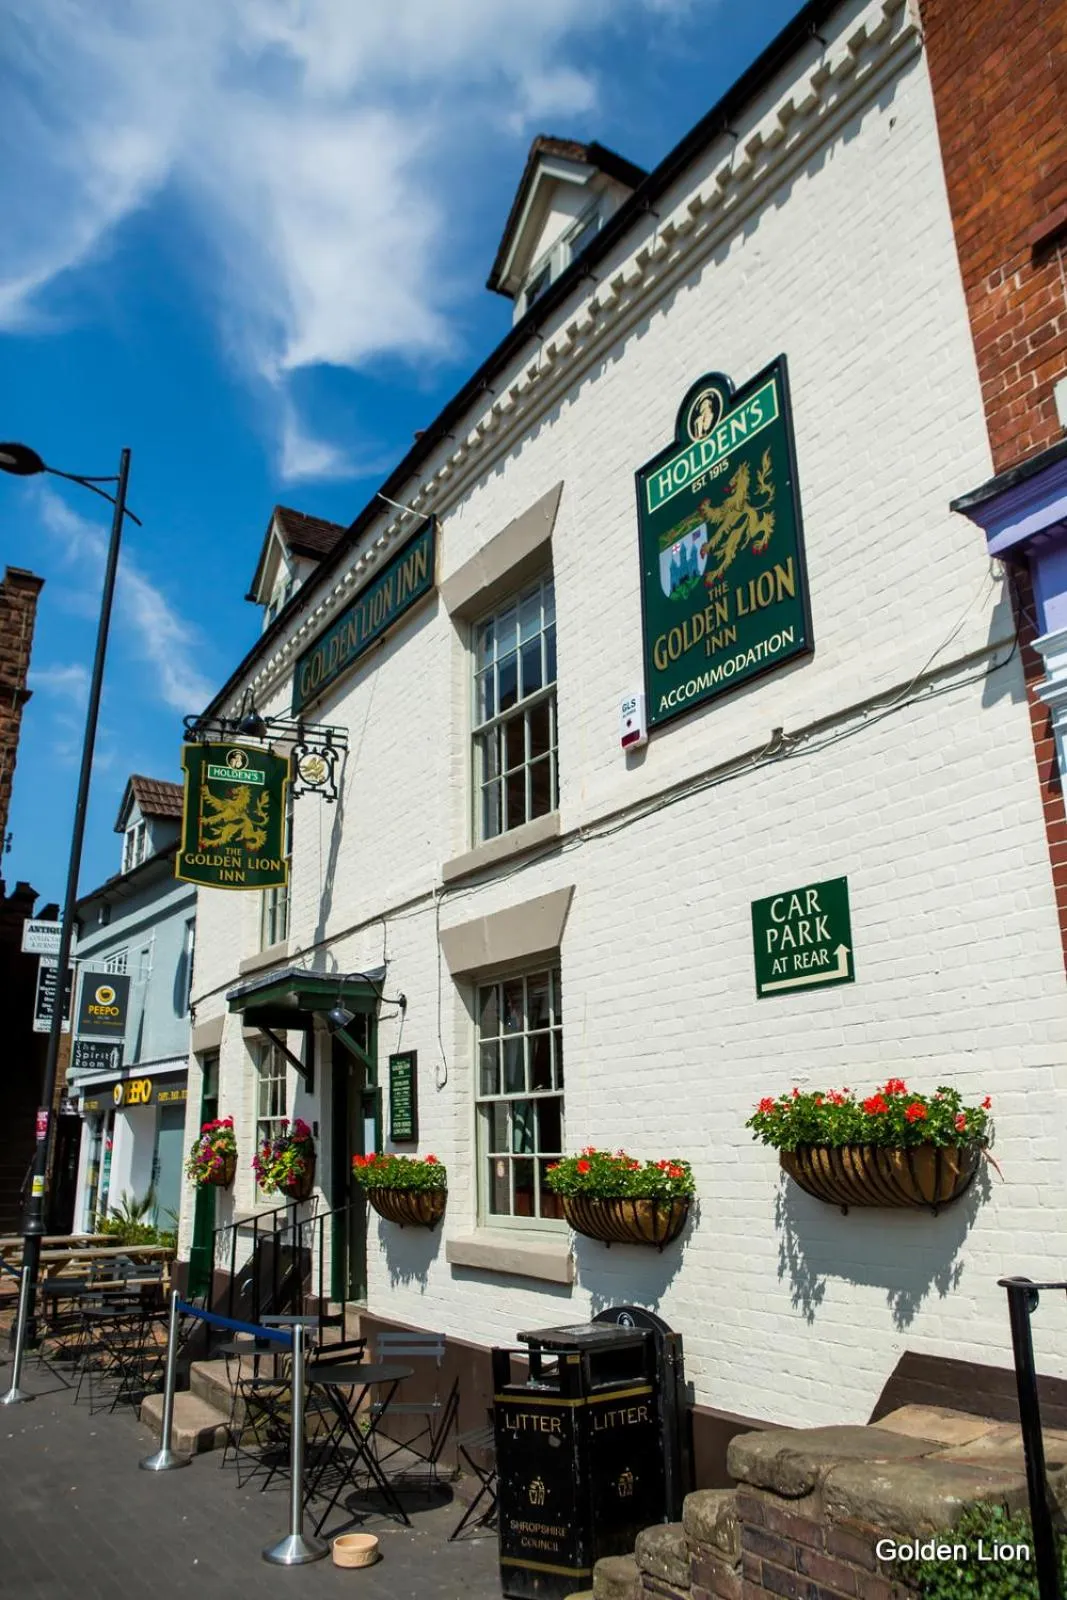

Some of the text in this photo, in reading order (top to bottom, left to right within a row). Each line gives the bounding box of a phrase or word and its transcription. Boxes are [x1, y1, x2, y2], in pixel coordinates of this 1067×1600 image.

[658, 399, 763, 498] HOLDEN'S
[691, 459, 730, 493] EST 1915
[707, 580, 729, 601] THE
[301, 540, 428, 697] GOLDEN LION INN
[653, 556, 796, 671] GOLDEN LION
[706, 625, 737, 656] INN
[659, 626, 795, 712] ACCOMMODATION
[213, 767, 259, 781] HOLDEN'S
[184, 852, 281, 871] GOLDEN LION
[225, 847, 242, 856] THE
[218, 870, 246, 882] INN
[770, 889, 822, 923] CAR
[765, 915, 832, 953] PARK
[771, 948, 830, 975] AT REAR
[88, 1004, 120, 1016] PEEPO
[75, 1050, 109, 1060] Spirit
[75, 1058, 105, 1068] Room
[505, 1410, 561, 1433] LITTER
[593, 1405, 649, 1431] LITTER
[510, 1519, 567, 1537] SHROPSHIRE
[521, 1536, 559, 1552] COUNCIL
